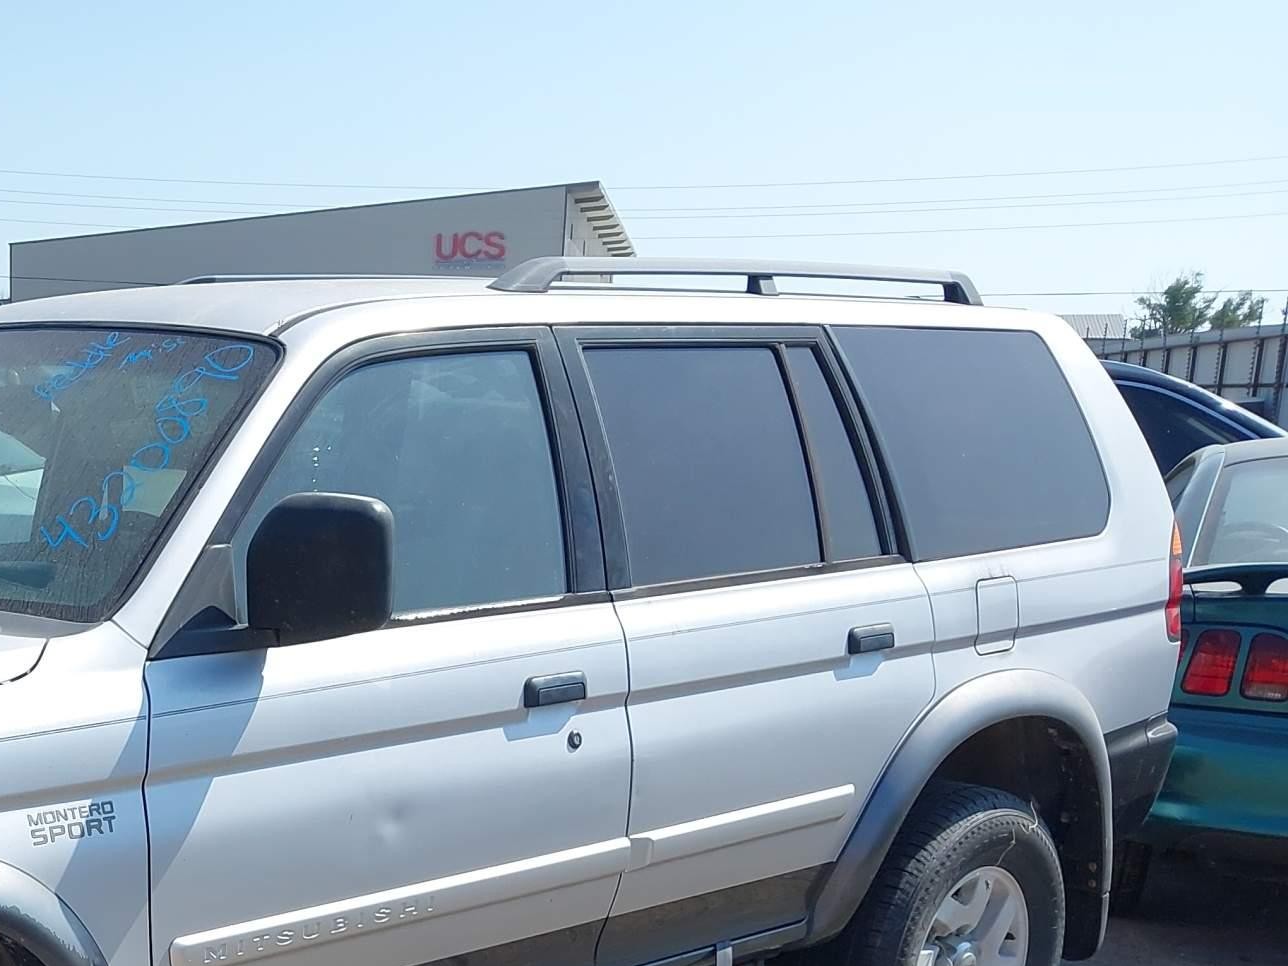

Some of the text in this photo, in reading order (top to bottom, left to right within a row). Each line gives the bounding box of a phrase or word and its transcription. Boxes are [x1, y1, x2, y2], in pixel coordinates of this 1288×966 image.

[434, 231, 506, 260] UCS
[26, 801, 115, 827] MONTERO
[30, 816, 116, 846] SPORT
[203, 896, 436, 964] MITSUBISHI
